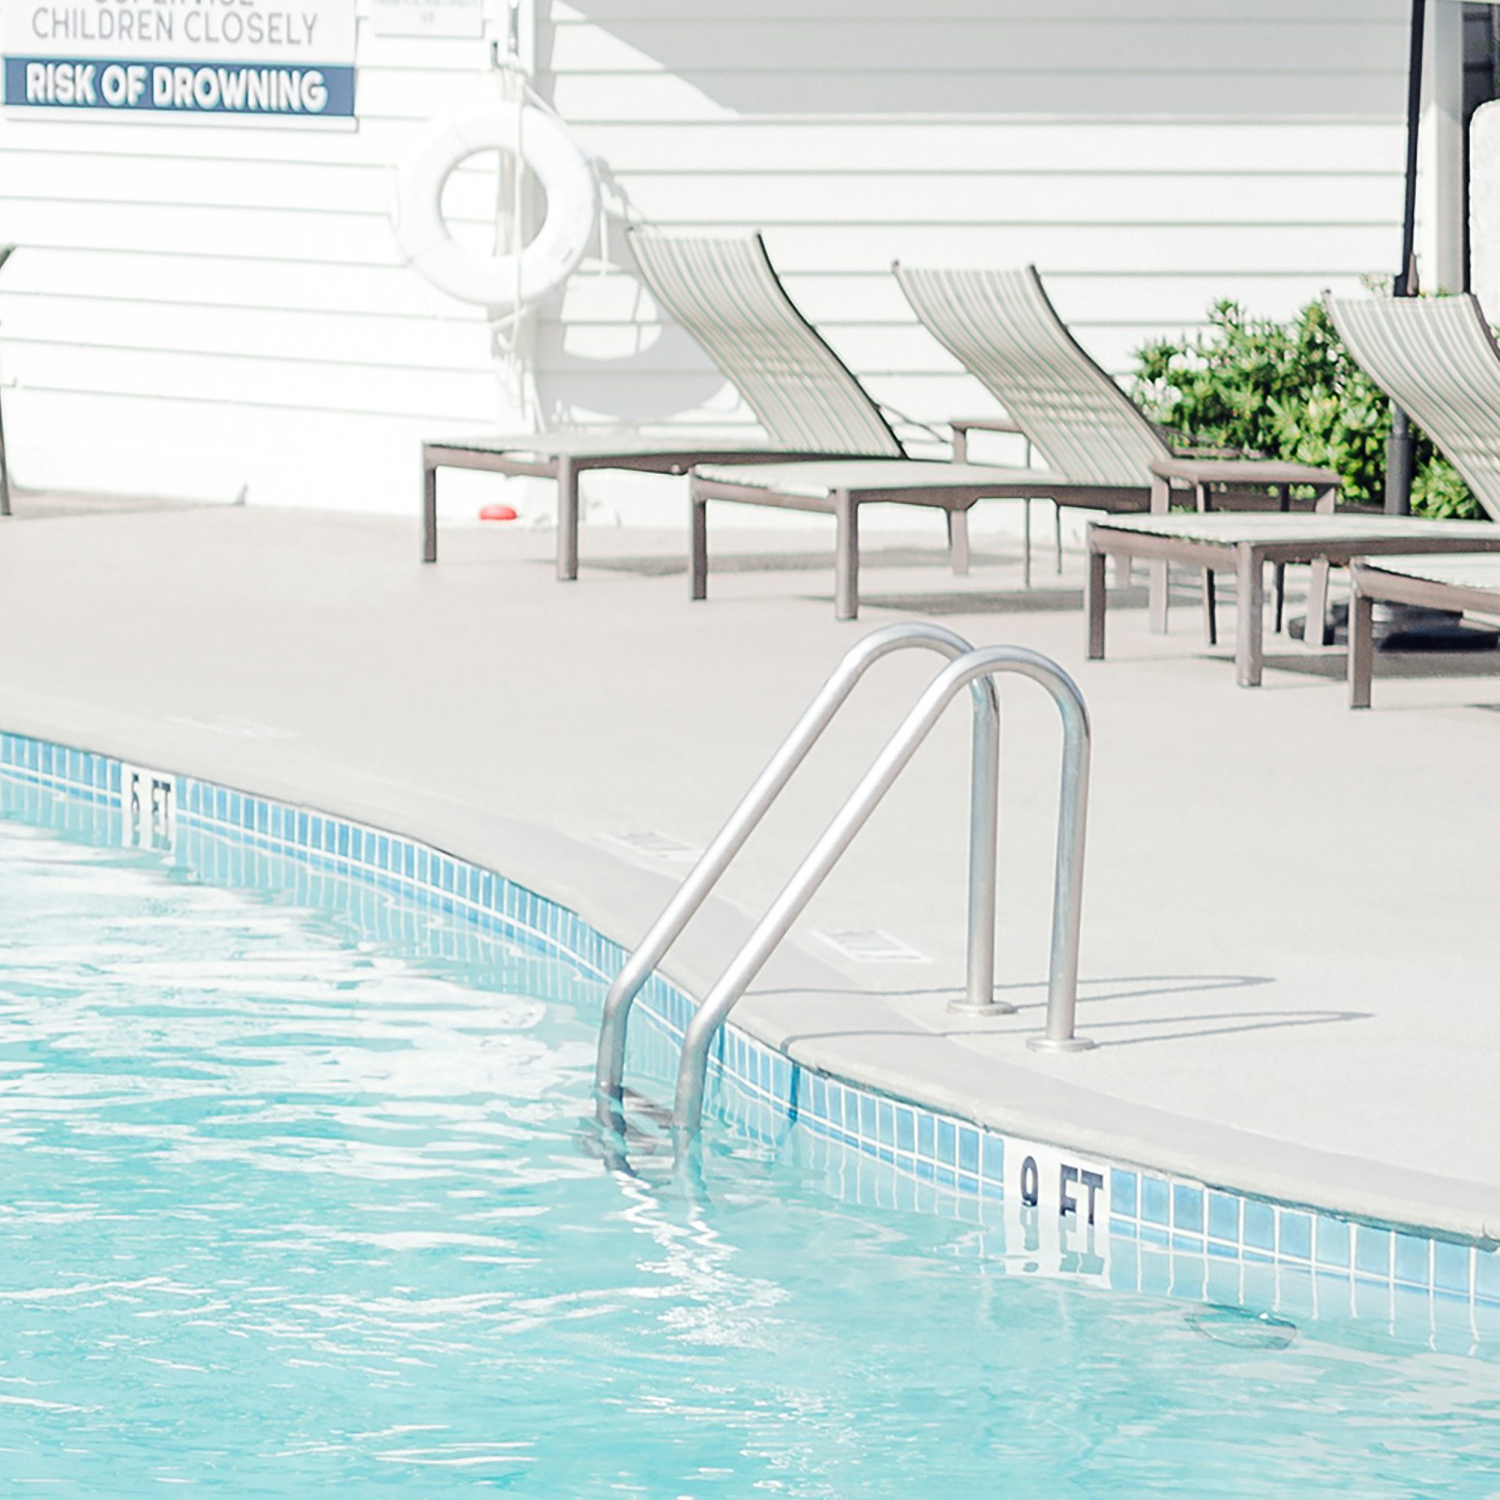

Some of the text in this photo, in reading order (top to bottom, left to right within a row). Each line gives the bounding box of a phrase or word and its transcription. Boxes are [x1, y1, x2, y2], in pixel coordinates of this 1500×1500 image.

[31, 7, 318, 46] CHILDREN CLOSELY
[26, 64, 328, 113] RISK OF DROWNING
[1059, 1163, 1104, 1226] FT
